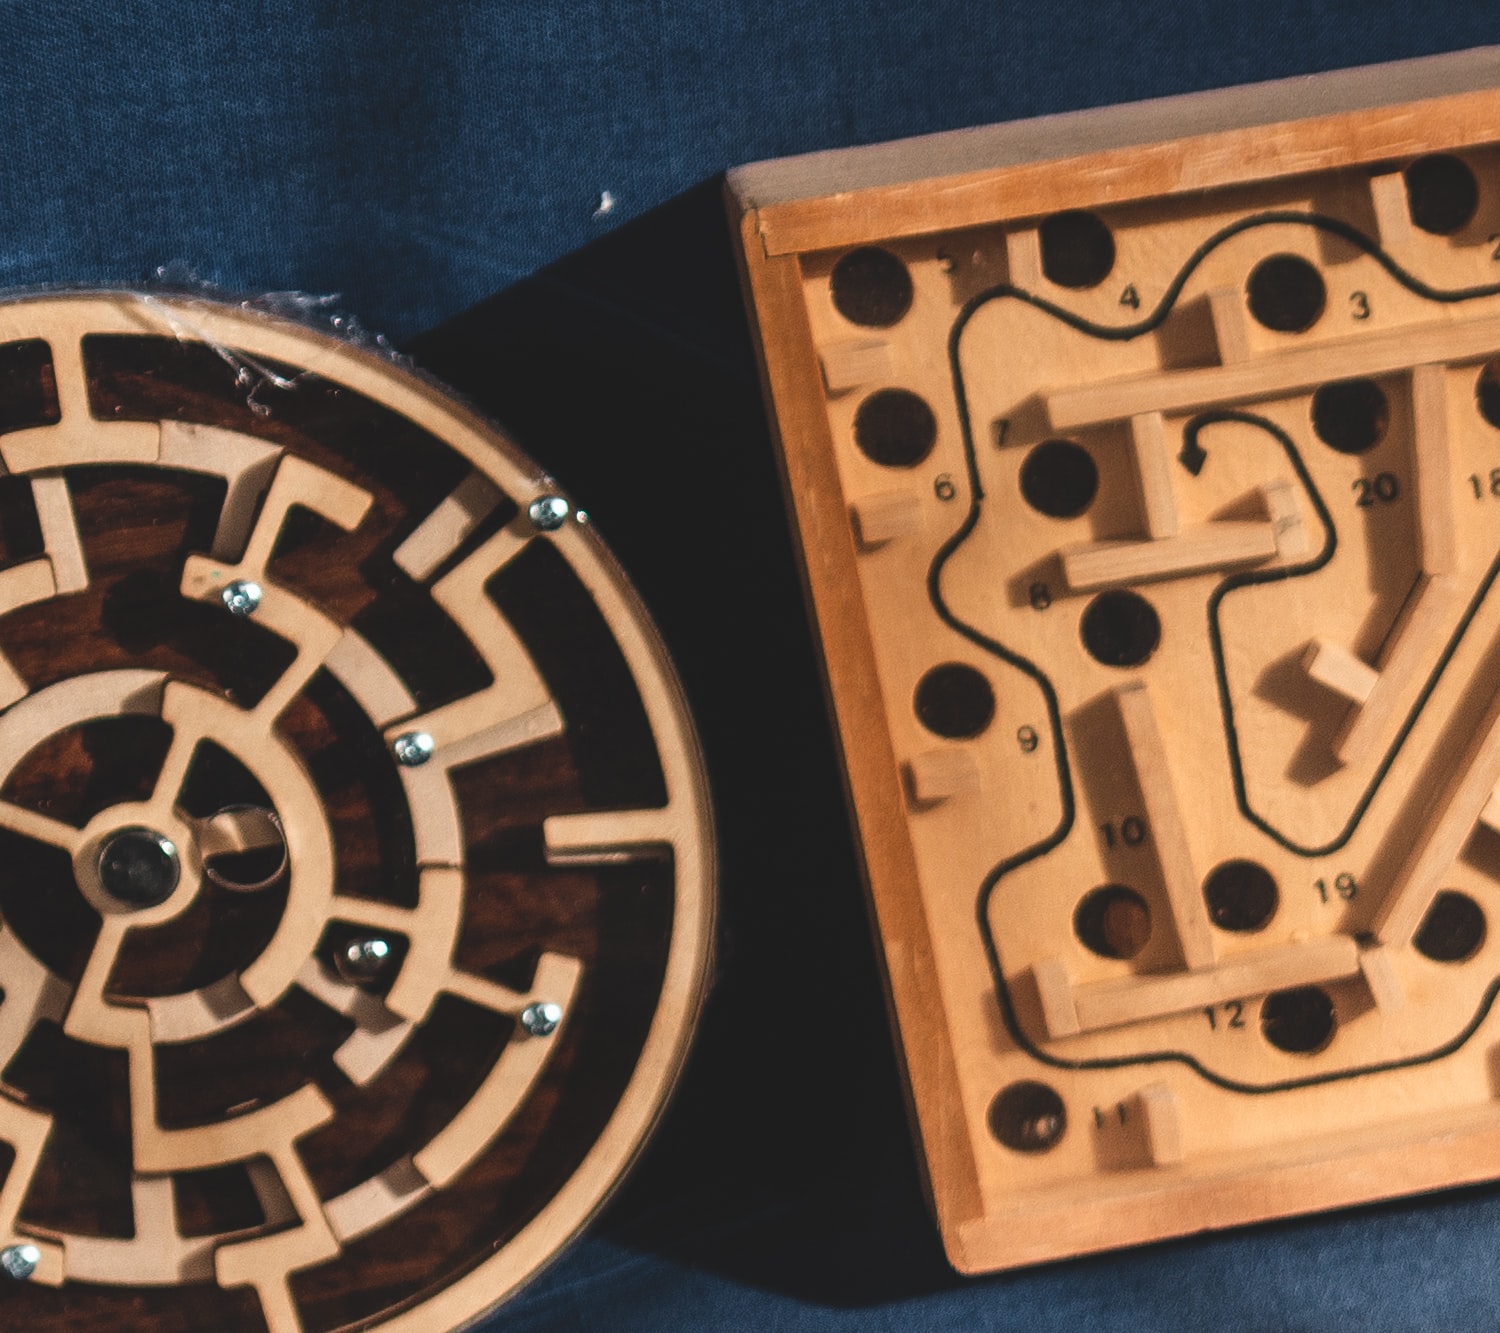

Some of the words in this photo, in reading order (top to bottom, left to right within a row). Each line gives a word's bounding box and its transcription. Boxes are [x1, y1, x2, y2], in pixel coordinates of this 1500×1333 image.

[1120, 283, 1140, 310] 4
[1348, 291, 1370, 320] 3
[934, 473, 956, 500] 6
[1352, 472, 1398, 508] 20
[1017, 725, 1039, 754] 9
[1101, 816, 1145, 847] 10
[1313, 872, 1359, 903] 19
[1205, 1001, 1247, 1031] 12
